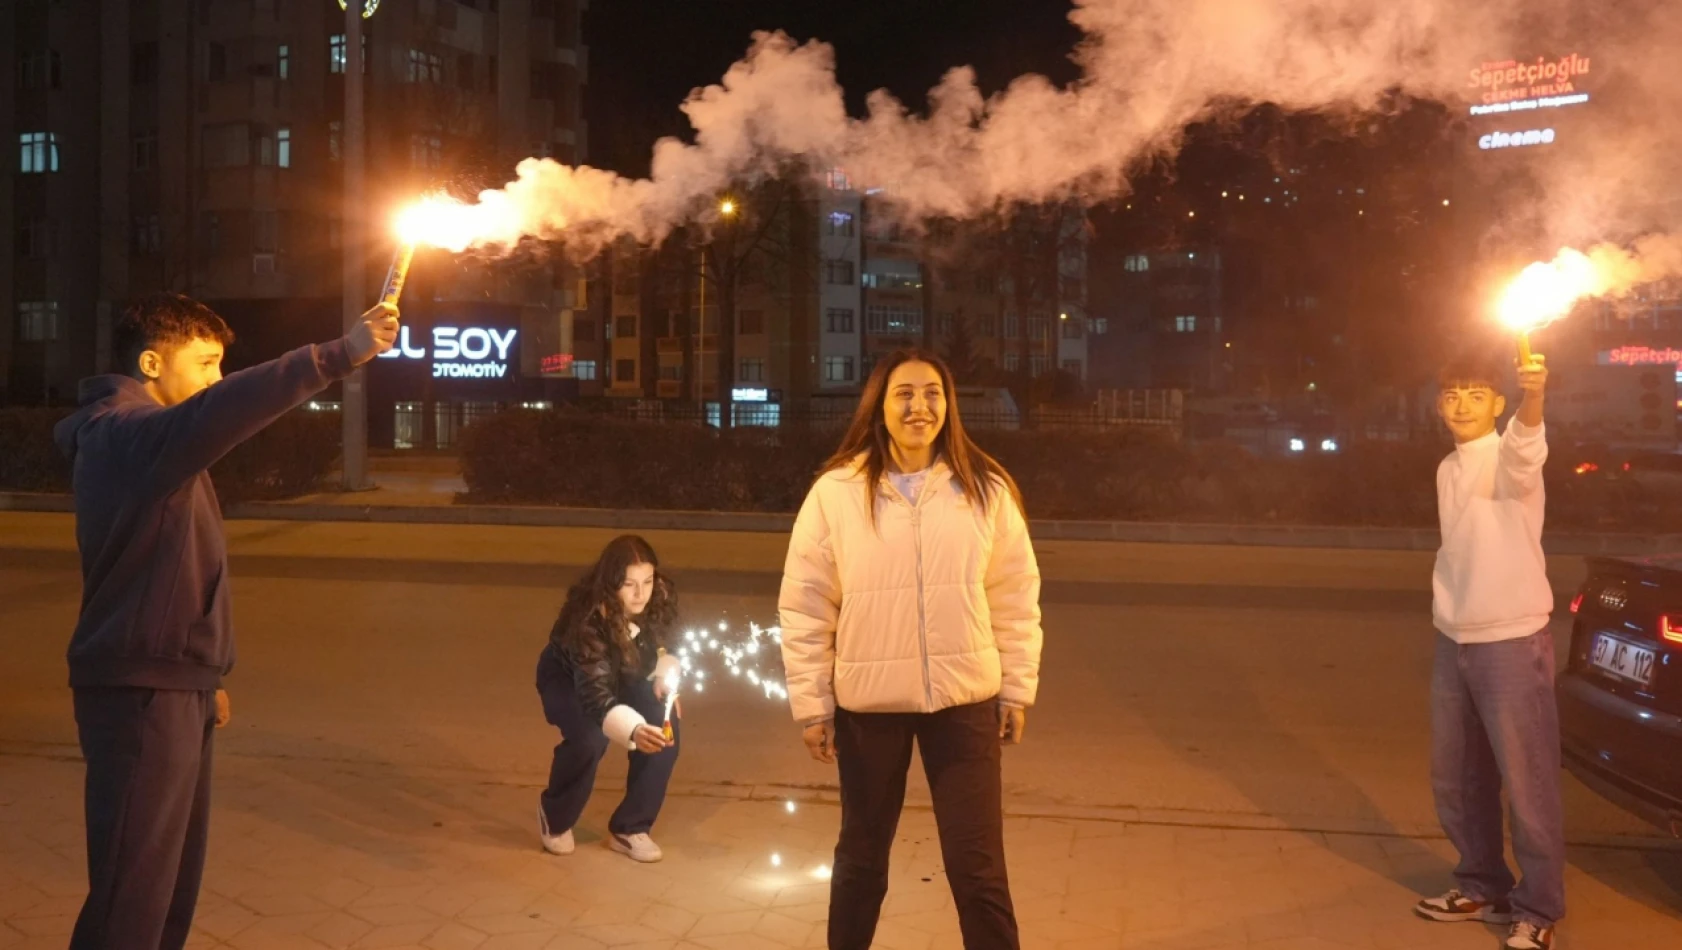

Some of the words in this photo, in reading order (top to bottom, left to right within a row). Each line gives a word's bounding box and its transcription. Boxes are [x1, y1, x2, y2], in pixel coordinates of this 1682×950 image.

[1468, 53, 1590, 91] Sepetçioğlu
[1531, 82, 1574, 97] HELVA
[433, 327, 517, 360] SOY
[1609, 346, 1682, 366] Sepetçio
[1595, 637, 1609, 664] 37
[1610, 643, 1628, 671] AC
[1632, 650, 1653, 681] 112
